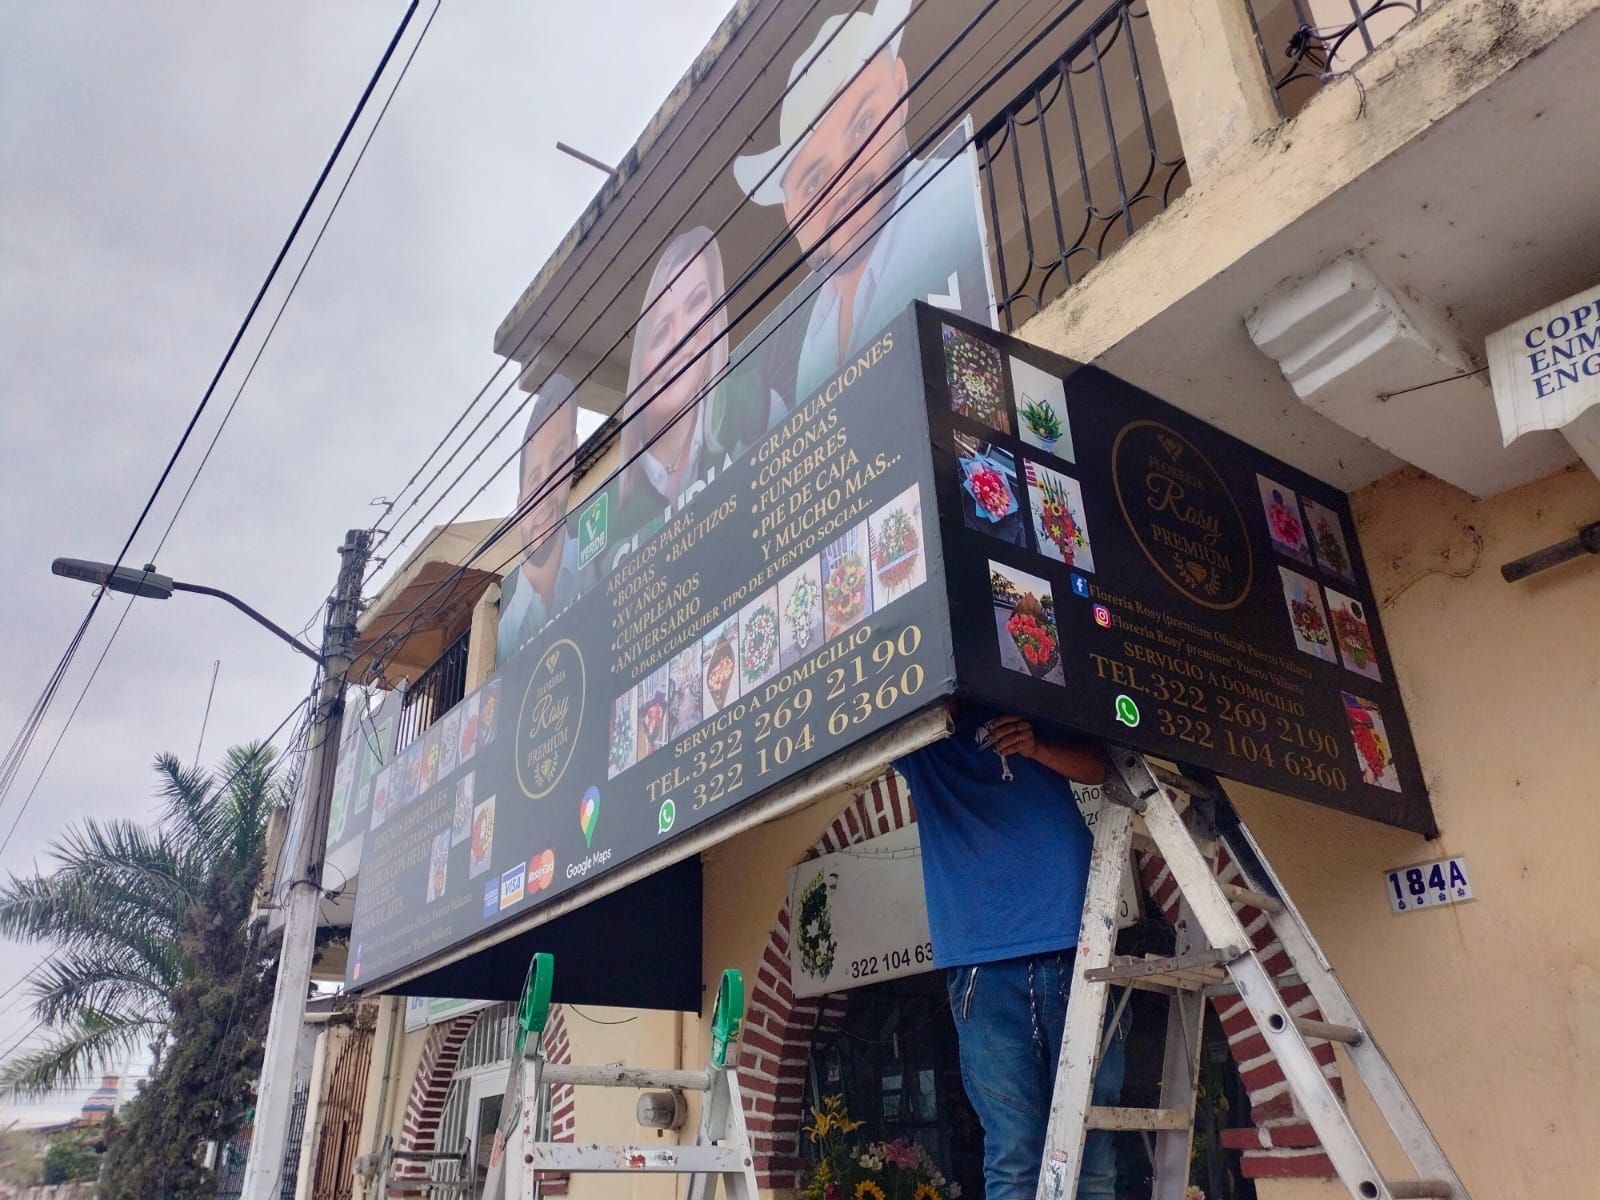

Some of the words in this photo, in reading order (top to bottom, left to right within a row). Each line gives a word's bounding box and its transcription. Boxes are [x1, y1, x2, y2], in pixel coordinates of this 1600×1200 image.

[759, 332, 894, 462] GRADUACIONES
[759, 407, 838, 486] CORONAS
[760, 427, 848, 512] FUNEBRES
[761, 504, 786, 537] PIE
[788, 482, 813, 515] DE
[815, 448, 860, 492] CAJA
[761, 539, 772, 561] Y
[775, 489, 841, 553] MUCHO
[1146, 472, 1224, 545] Rosy
[608, 541, 657, 593] AREGLOS
[659, 512, 694, 549] PARA:
[618, 564, 656, 607] BODAS
[671, 495, 737, 562] BAUTIZOS
[1151, 522, 1232, 573] PREMIUM
[616, 604, 633, 628] XV
[635, 576, 667, 614] AÑOS
[616, 572, 700, 650] CUMPLEAÑOS
[616, 597, 701, 674] ANIVERSARIO
[639, 649, 662, 673] PARA
[664, 606, 720, 655] CUALQUIER
[721, 587, 747, 612] TIPO
[748, 570, 765, 592] DE
[767, 535, 816, 578] EVENTO
[673, 707, 746, 758] SERVICIO
[749, 695, 761, 713] A
[765, 625, 873, 703] DOMICILIO
[755, 688, 814, 744] 269
[826, 624, 922, 702] 2190
[1123, 640, 1204, 681] SERVICIO
[1208, 672, 1219, 688] A
[1222, 676, 1306, 718] DOMICILIO
[528, 727, 568, 768] PREMIUM
[692, 762, 744, 811] 322
[756, 724, 816, 777] 104
[827, 663, 926, 737] 6360
[1157, 708, 1214, 749] 322
[1224, 729, 1275, 769] 104
[1284, 750, 1348, 792] 6360
[1216, 695, 1268, 732] 269
[1276, 717, 1340, 760] 2190
[504, 876, 521, 896] VISA
[566, 856, 592, 880] Google
[592, 848, 612, 867] Maps
[1389, 860, 1467, 900] 184A
[851, 957, 878, 979] 322
[883, 949, 911, 973] 104
